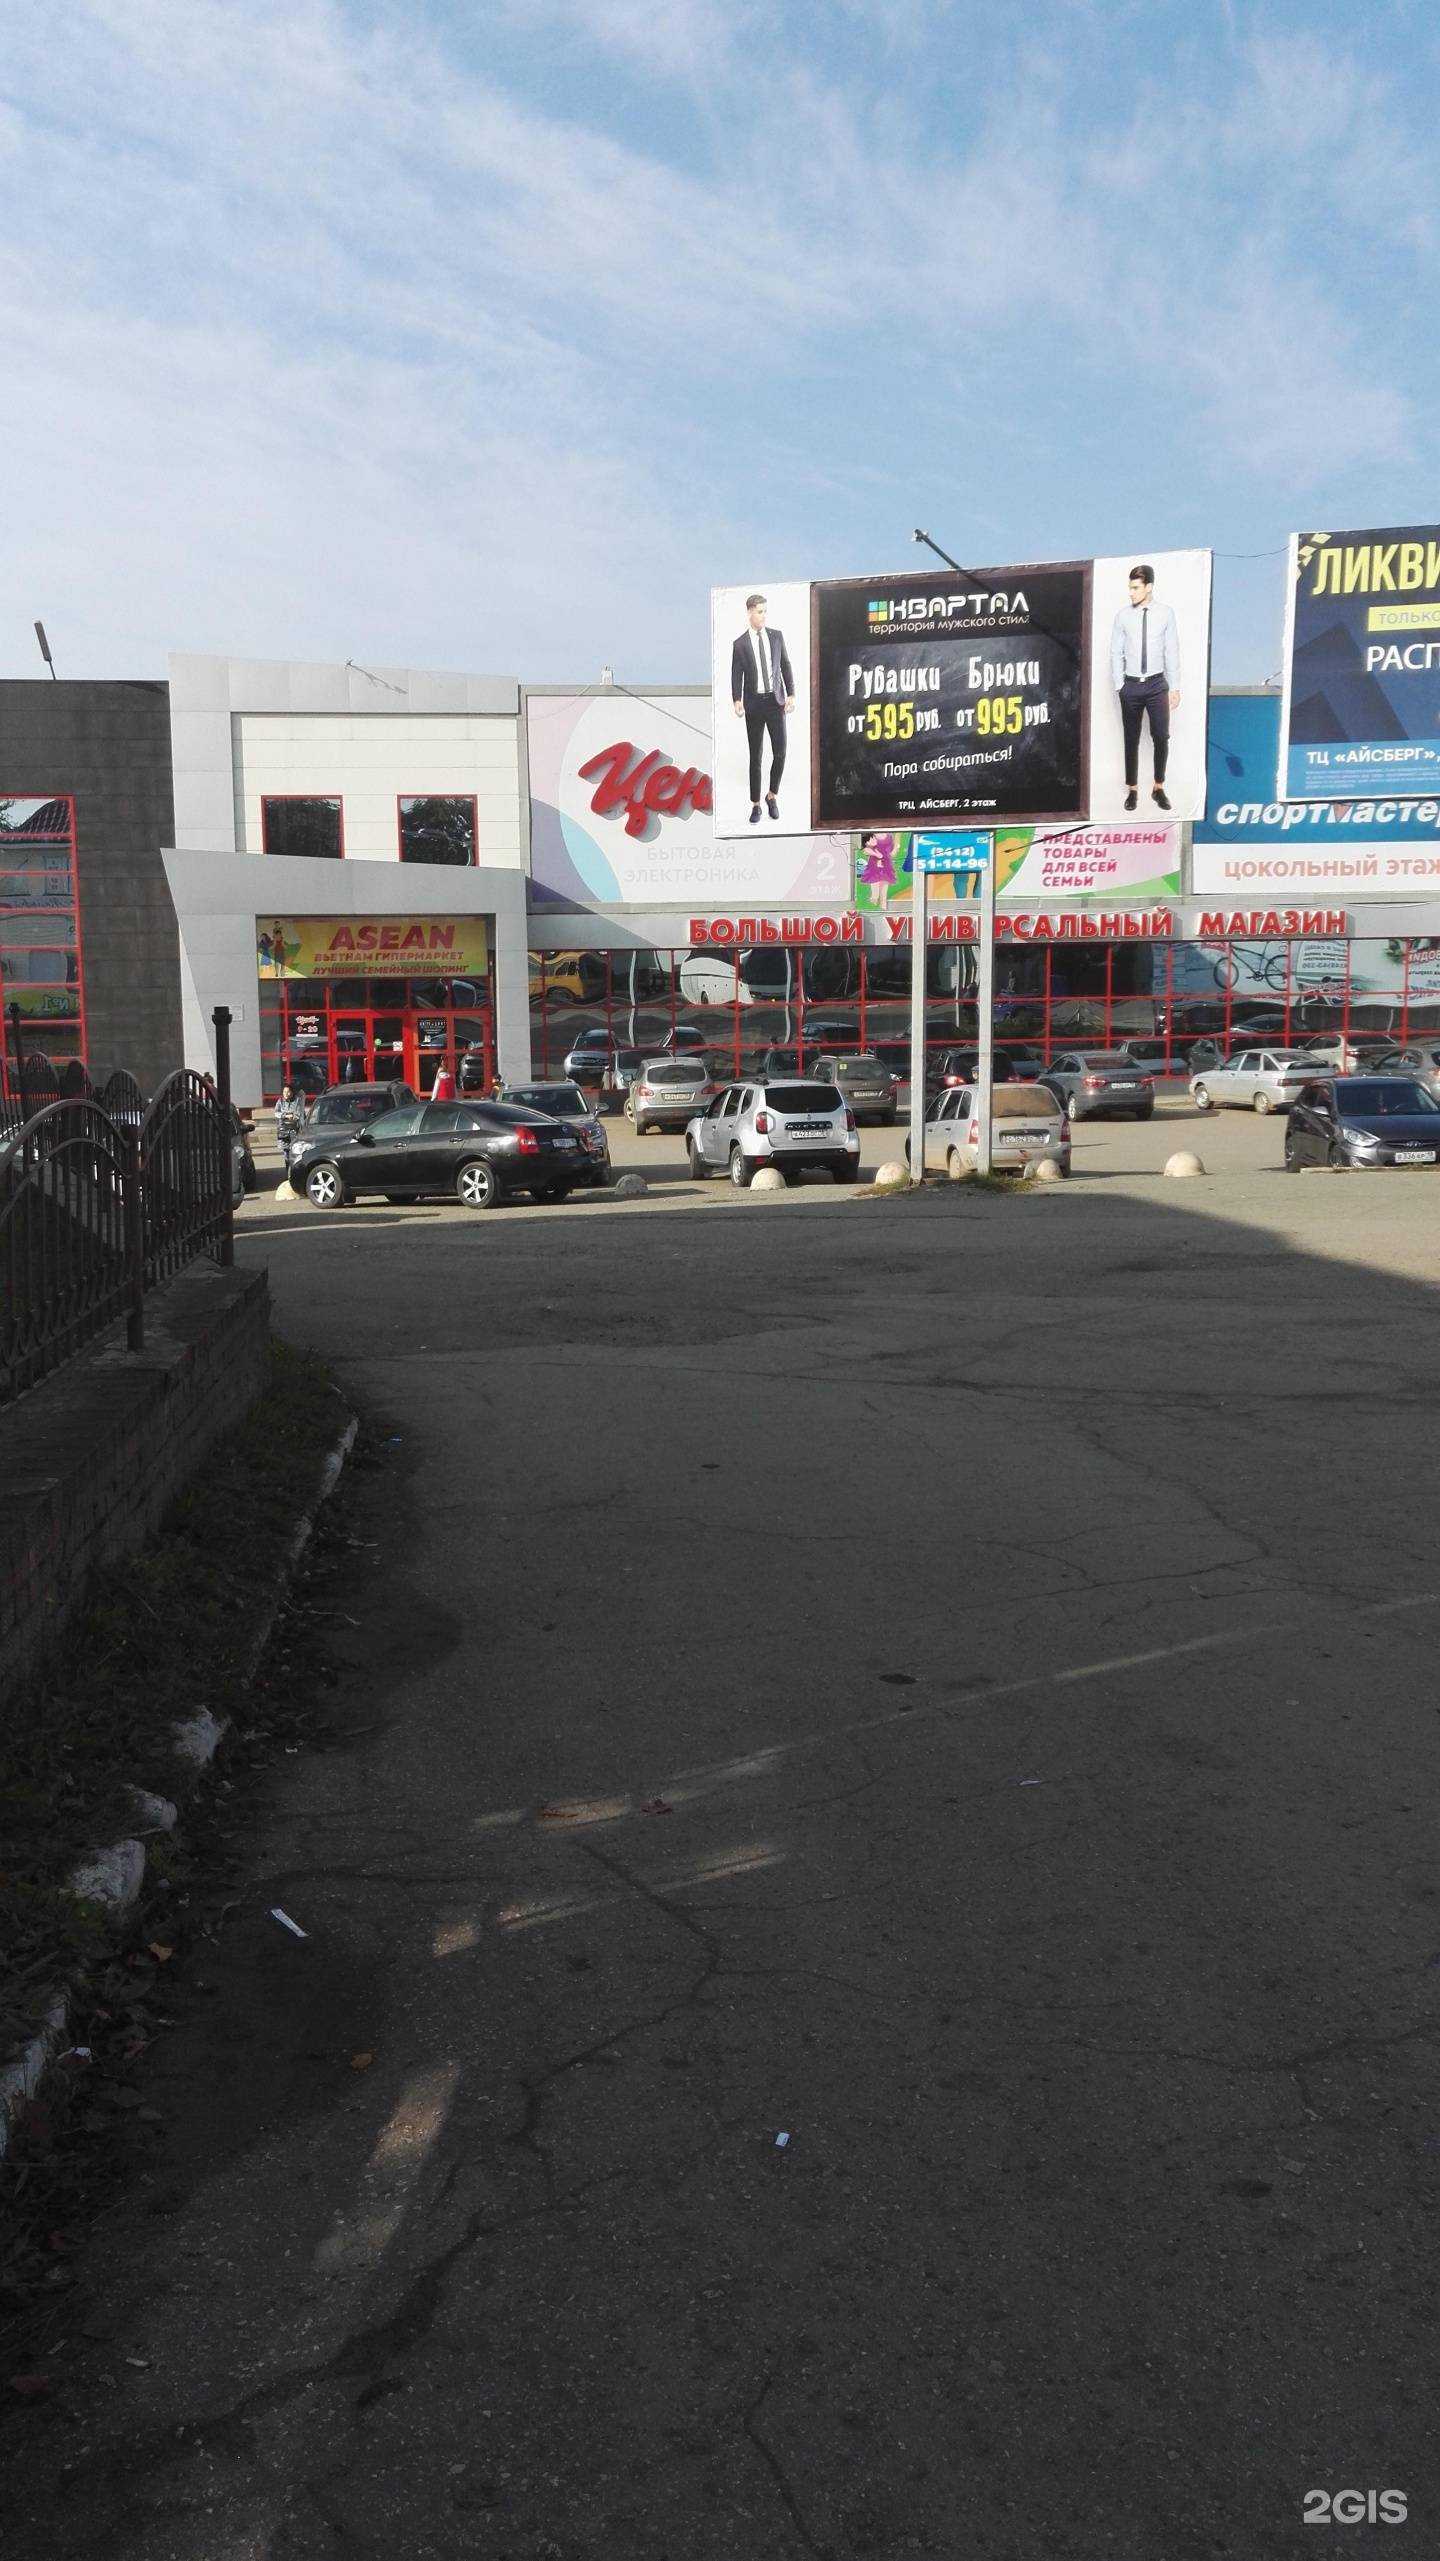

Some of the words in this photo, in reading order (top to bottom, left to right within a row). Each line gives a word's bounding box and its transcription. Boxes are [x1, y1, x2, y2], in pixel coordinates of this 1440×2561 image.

[869, 621, 935, 635] территория
[938, 615, 996, 632] мужского
[848, 664, 941, 699] Рубашки
[968, 656, 1040, 691] Брюки
[847, 715, 866, 733] от
[866, 702, 915, 741] 595
[956, 708, 975, 727] от
[976, 696, 1023, 735] 995
[884, 762, 918, 778] Пора
[923, 744, 1013, 772] собираться!
[1307, 751, 1329, 766] ТЦ
[898, 801, 916, 811] ТРЦ
[964, 799, 970, 808] 2
[971, 798, 997, 807] этаж
[1216, 801, 1440, 830] спортмасте
[1043, 833, 1167, 845] ПРЕДСТАВЛЕНЫ
[647, 847, 736, 862] БЫТОВАЯ
[1044, 847, 1107, 859] ТОВАРЫ
[624, 868, 761, 884] ЭЛЕКТРОНИКА
[815, 852, 838, 881] 2
[1042, 861, 1075, 875] ДЛЯ
[1079, 859, 1118, 873] ВСЕЙ
[1224, 854, 1378, 881] цокольный
[1043, 875, 1094, 887] СЕМЬИ
[328, 925, 456, 951] ASEAN
[689, 911, 865, 944] БОЛЬШОЙ
[1198, 910, 1346, 936] МАГАЗИН
